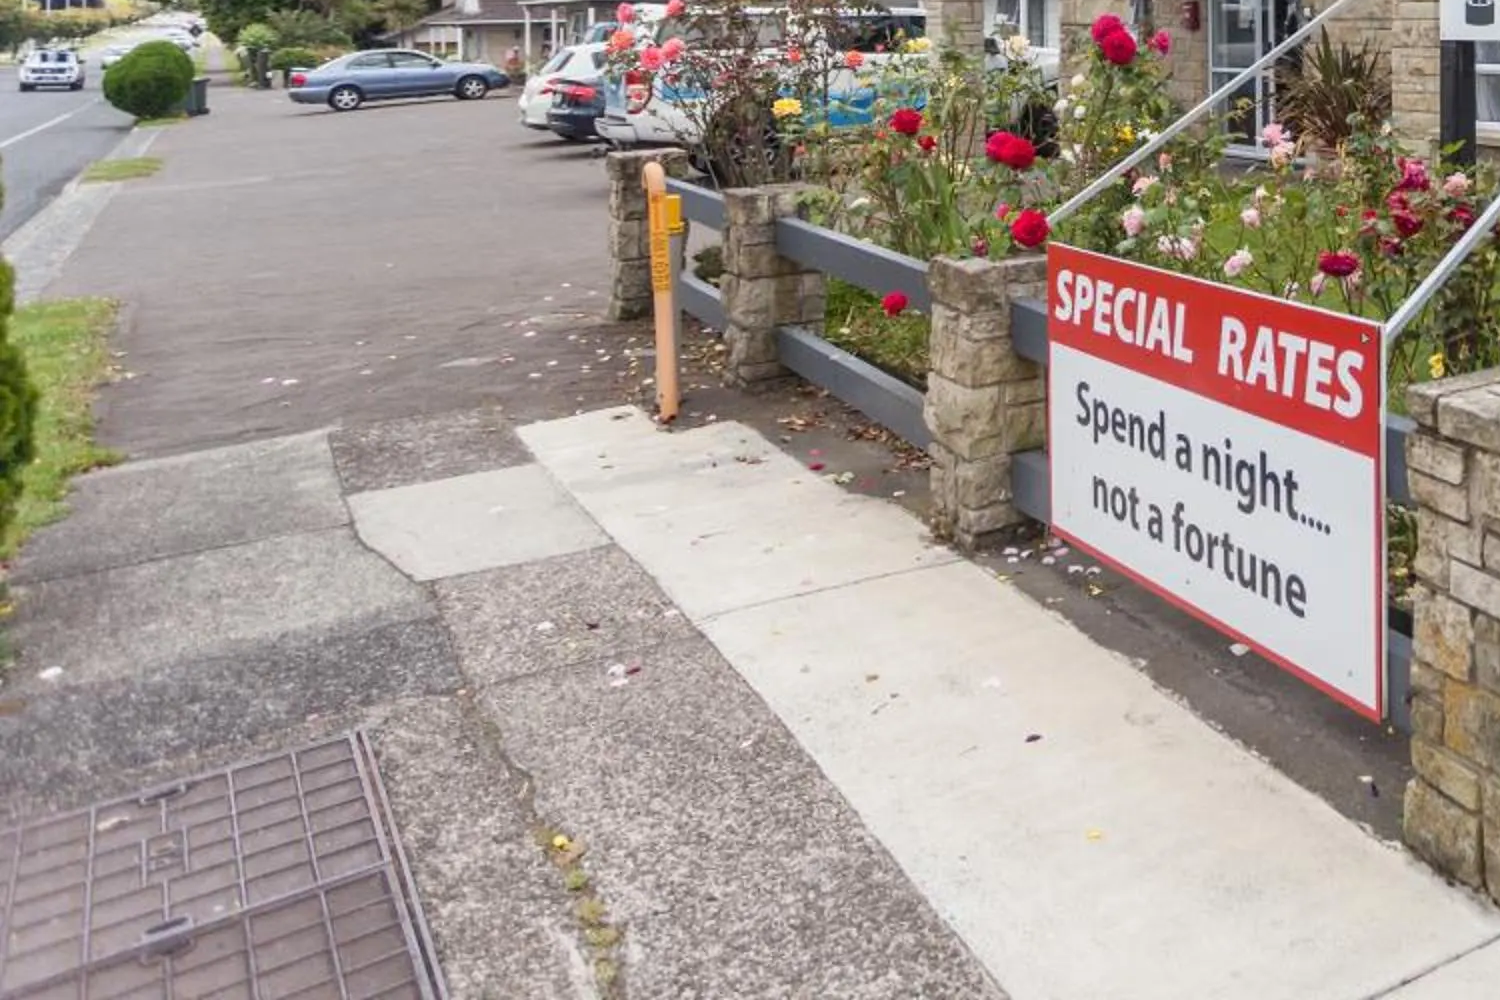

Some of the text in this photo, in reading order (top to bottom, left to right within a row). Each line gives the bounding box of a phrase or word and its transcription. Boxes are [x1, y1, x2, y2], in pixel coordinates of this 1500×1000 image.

[1055, 269, 1364, 419] SPECIAL RATES
[1076, 381, 1165, 463] Spend
[1177, 433, 1192, 472] a
[1093, 475, 1308, 618] not a fortune
